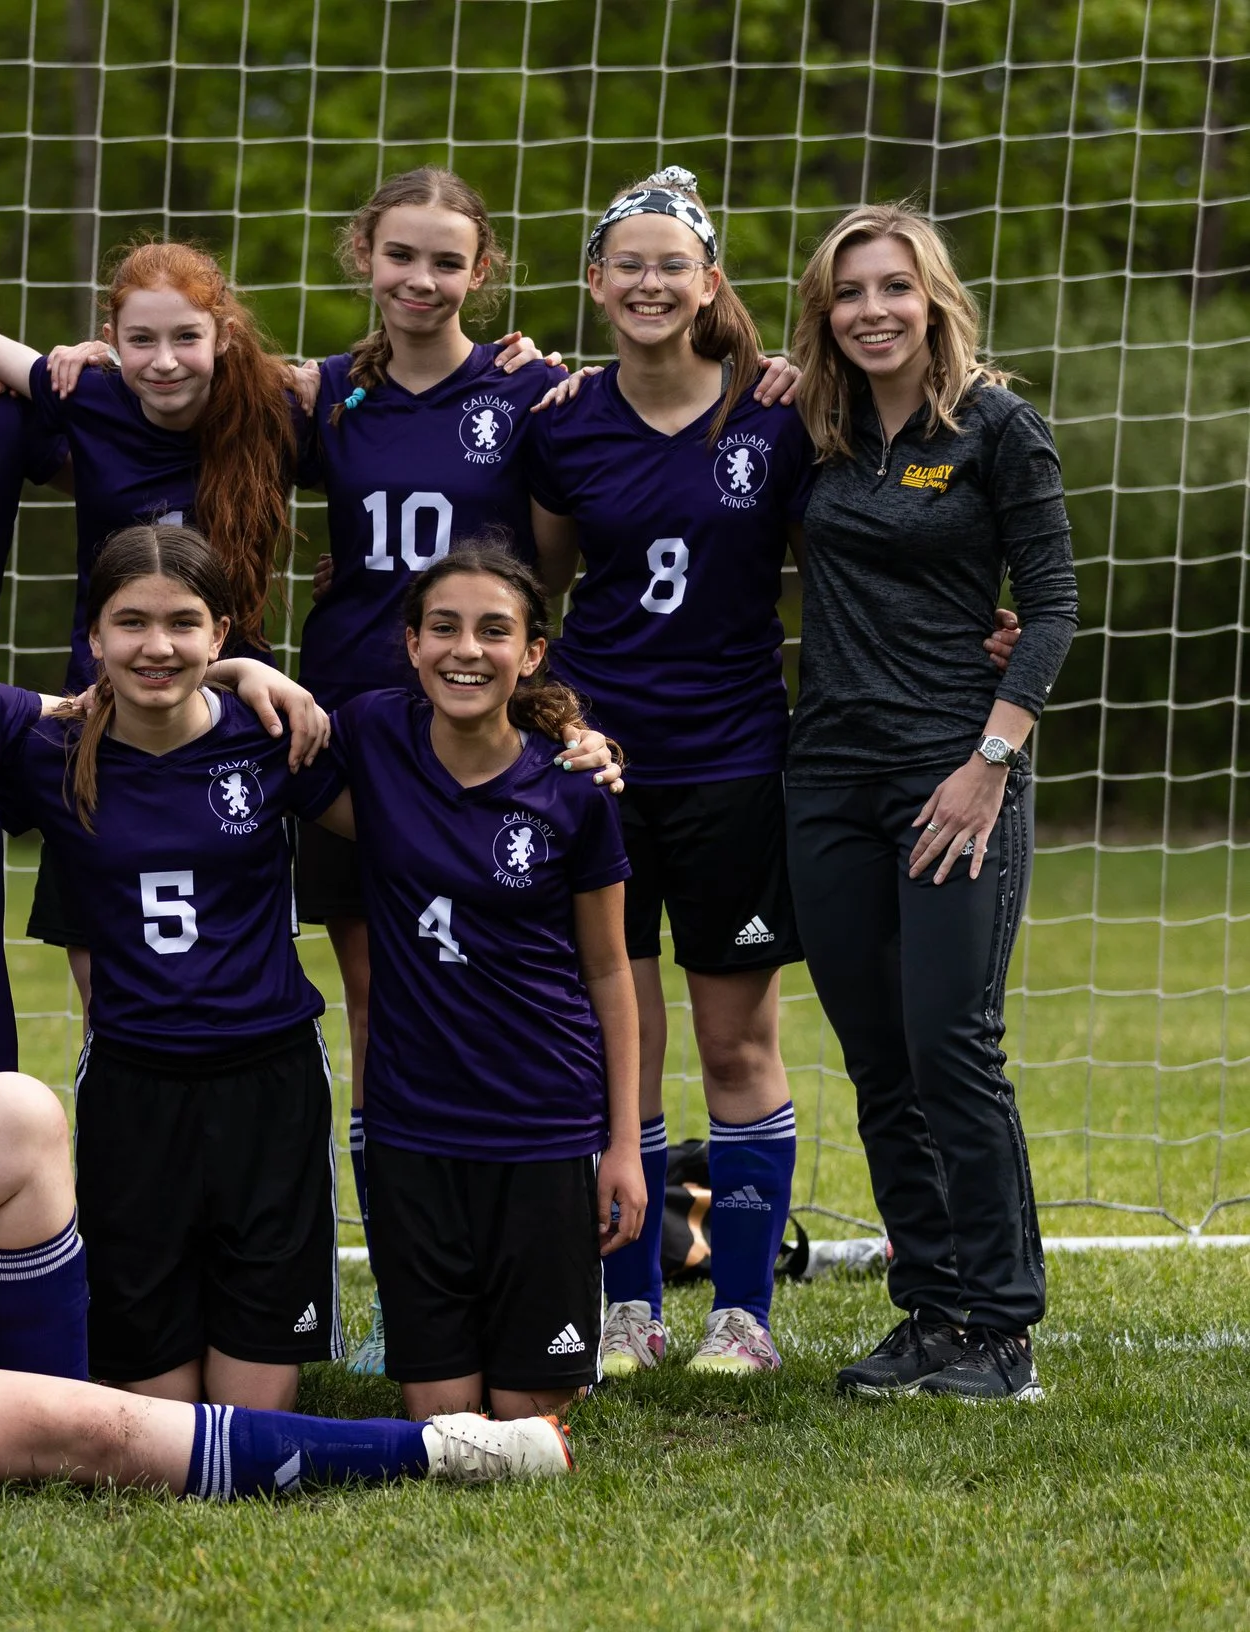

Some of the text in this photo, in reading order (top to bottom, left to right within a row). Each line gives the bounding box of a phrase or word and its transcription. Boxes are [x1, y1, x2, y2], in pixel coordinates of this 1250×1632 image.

[462, 395, 516, 413] CALVARY
[717, 433, 772, 453] CALVARY
[464, 451, 502, 465] KINGS
[719, 494, 757, 509] KINGS
[362, 490, 454, 572] 10
[639, 537, 690, 615] 8
[208, 759, 263, 777] CALVARY
[220, 819, 259, 835] KINGS
[503, 810, 556, 837] CALVARY
[493, 869, 533, 889] KINGS
[139, 870, 199, 955] 5
[417, 895, 468, 965] 4
[734, 932, 775, 946] adidas
[715, 1199, 772, 1211] adidas
[547, 1341, 586, 1355] adidas
